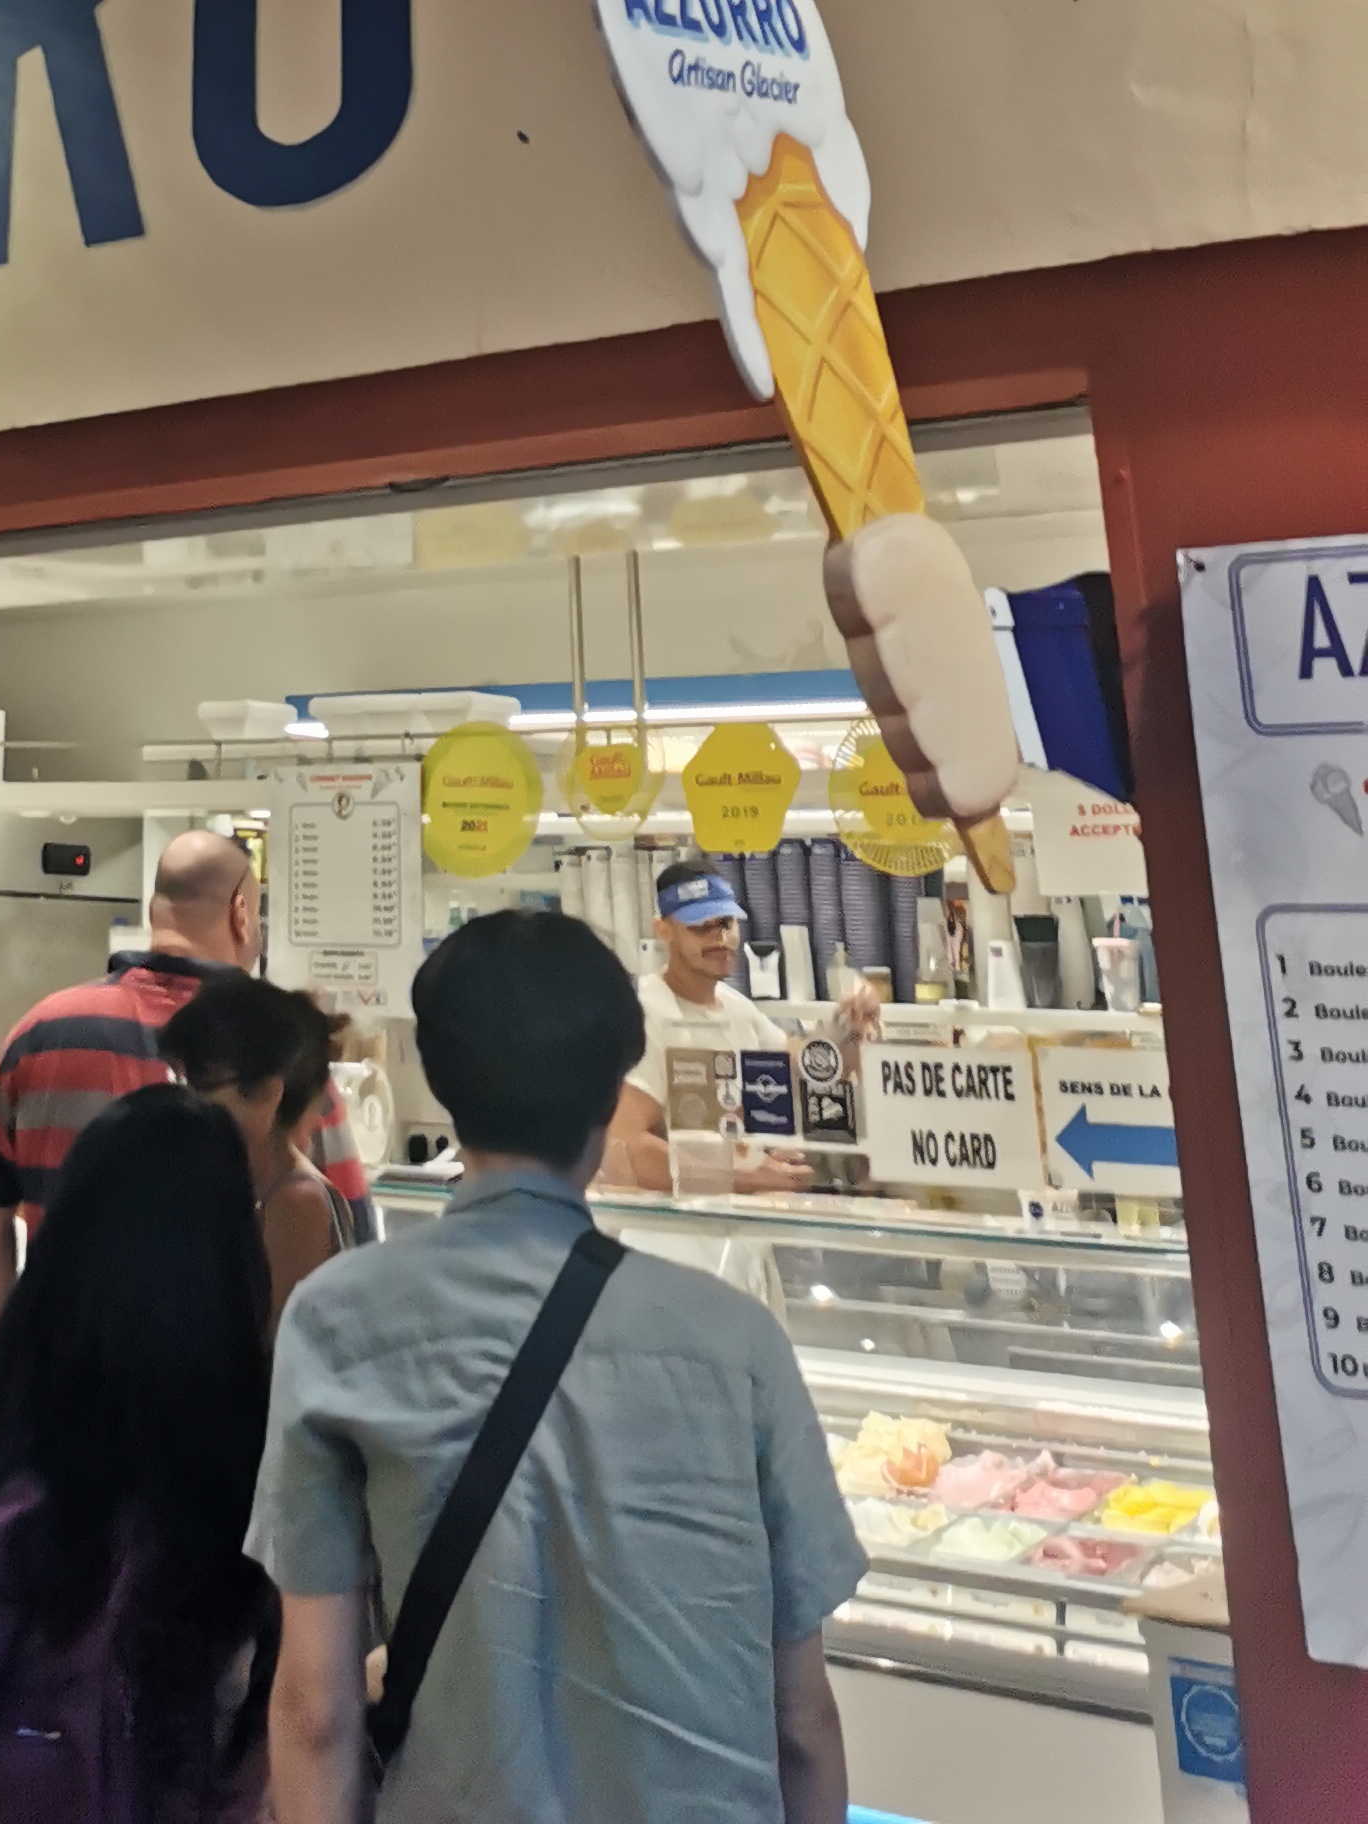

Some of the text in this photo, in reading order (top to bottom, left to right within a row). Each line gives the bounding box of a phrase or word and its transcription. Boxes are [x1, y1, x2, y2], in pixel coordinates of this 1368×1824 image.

[741, 60, 801, 105] Glacier
[1275, 953, 1287, 977] 1
[1282, 997, 1299, 1019] 2
[1287, 1039, 1304, 1062] 3
[881, 1060, 1016, 1102] PAS DE CARTE
[1059, 1079, 1162, 1099] SENS DE LA
[1294, 1083, 1313, 1105] 4
[911, 1128, 997, 1170] NO CARD
[1301, 1127, 1315, 1149] 5
[1305, 1171, 1323, 1194] 6
[1309, 1216, 1326, 1238] 7
[1317, 1261, 1335, 1284] 8
[1322, 1305, 1340, 1330] 9
[1328, 1352, 1359, 1377] 10
